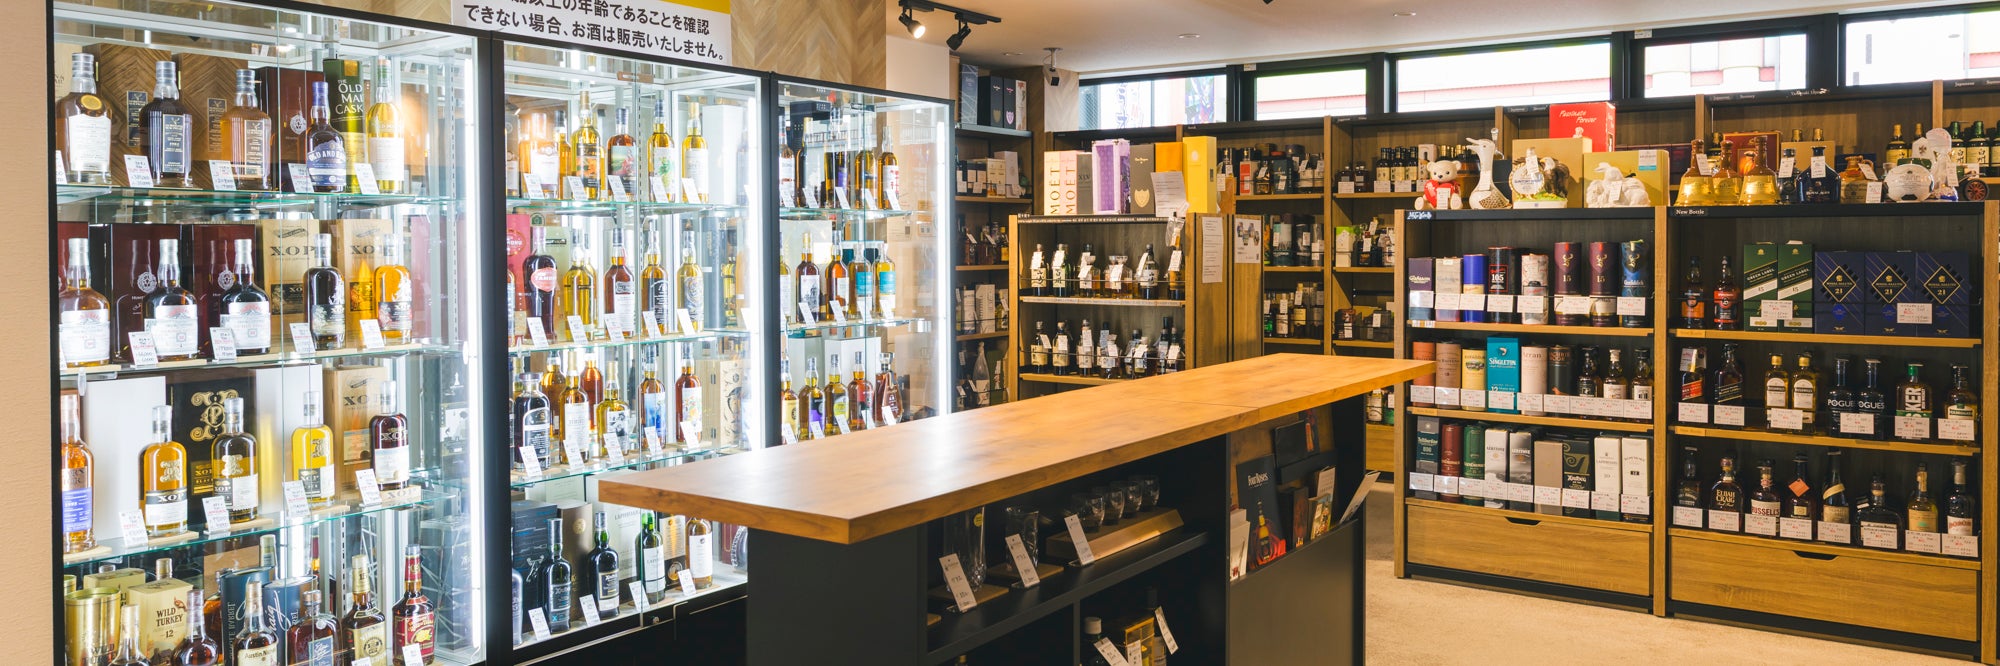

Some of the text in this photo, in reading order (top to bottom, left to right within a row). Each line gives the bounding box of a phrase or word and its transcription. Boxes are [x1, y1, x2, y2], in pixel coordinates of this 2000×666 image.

[463, 3, 724, 61] できない場合、お酒は販売いたしません。
[338, 84, 363, 94] OLD
[335, 104, 364, 115] CASK
[1491, 273, 1505, 281] 105
[1563, 274, 1571, 282] 15
[1596, 275, 1605, 283] 15
[1746, 267, 1775, 281] GREEN LABEL
[1780, 267, 1810, 281] GREEN LABEL
[156, 607, 176, 618] WILD
[156, 614, 184, 627] TURKEY
[165, 630, 174, 638] 12
